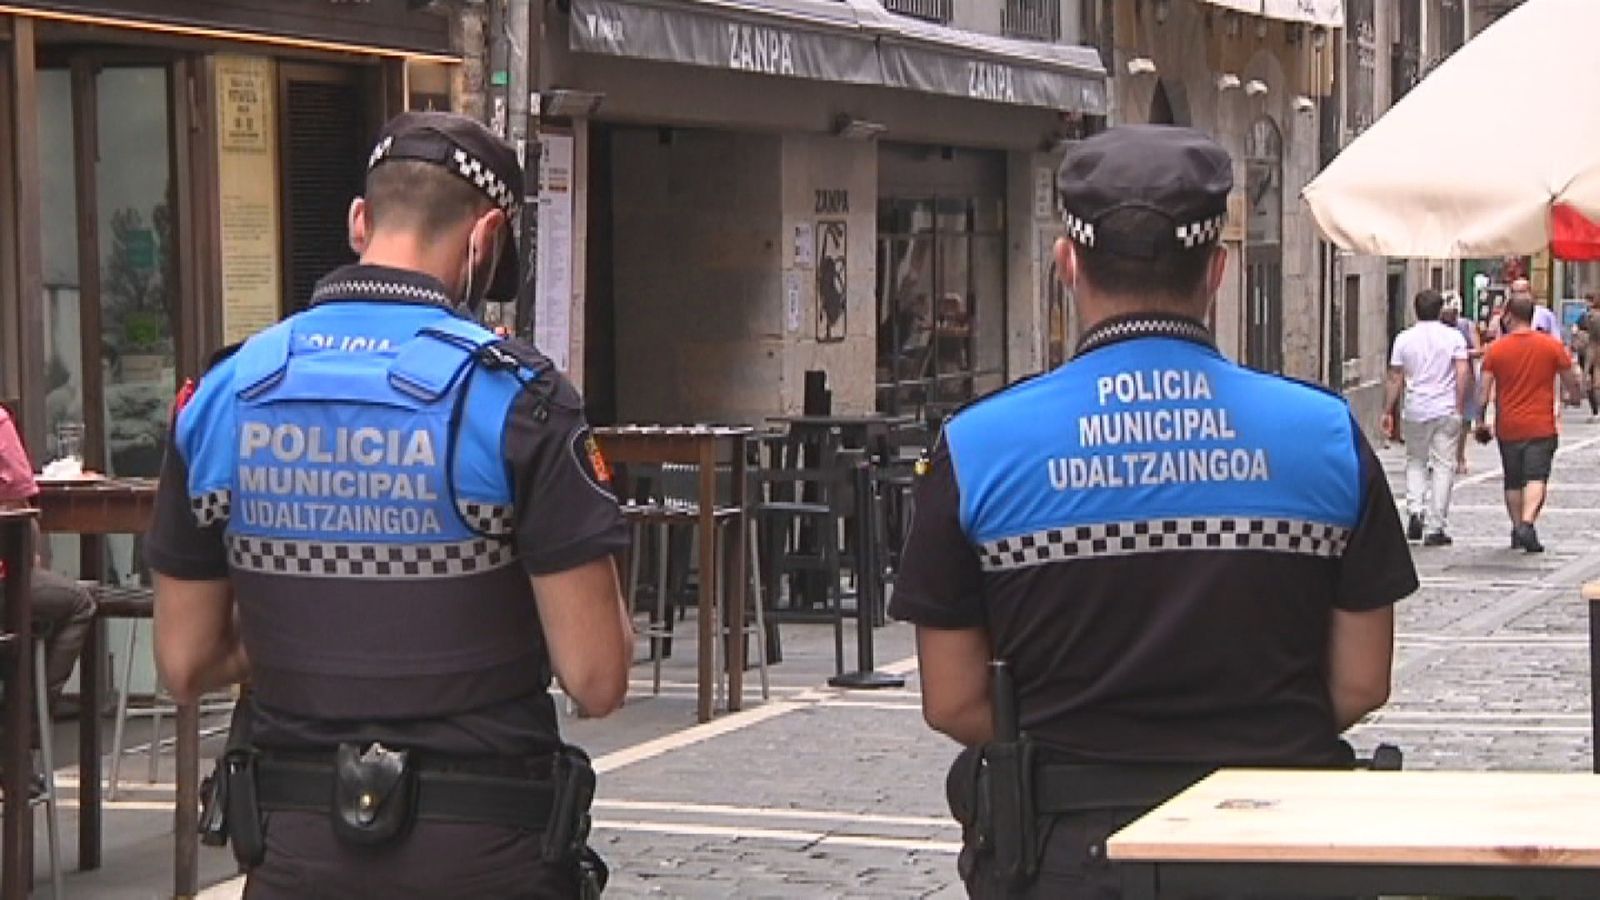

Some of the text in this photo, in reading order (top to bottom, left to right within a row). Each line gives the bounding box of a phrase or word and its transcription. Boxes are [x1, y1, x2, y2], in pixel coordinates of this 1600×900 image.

[728, 23, 794, 75] ZANPA
[968, 61, 1014, 103] ZANPA
[1097, 370, 1212, 405] POLICIA
[239, 422, 435, 466] POLICIA
[1078, 408, 1235, 447] MUNICIPAL
[239, 465, 438, 500] MUNICIPAL
[1048, 448, 1269, 490] UDALTZAINGOA
[241, 500, 441, 534] UDALTZAINGOA
